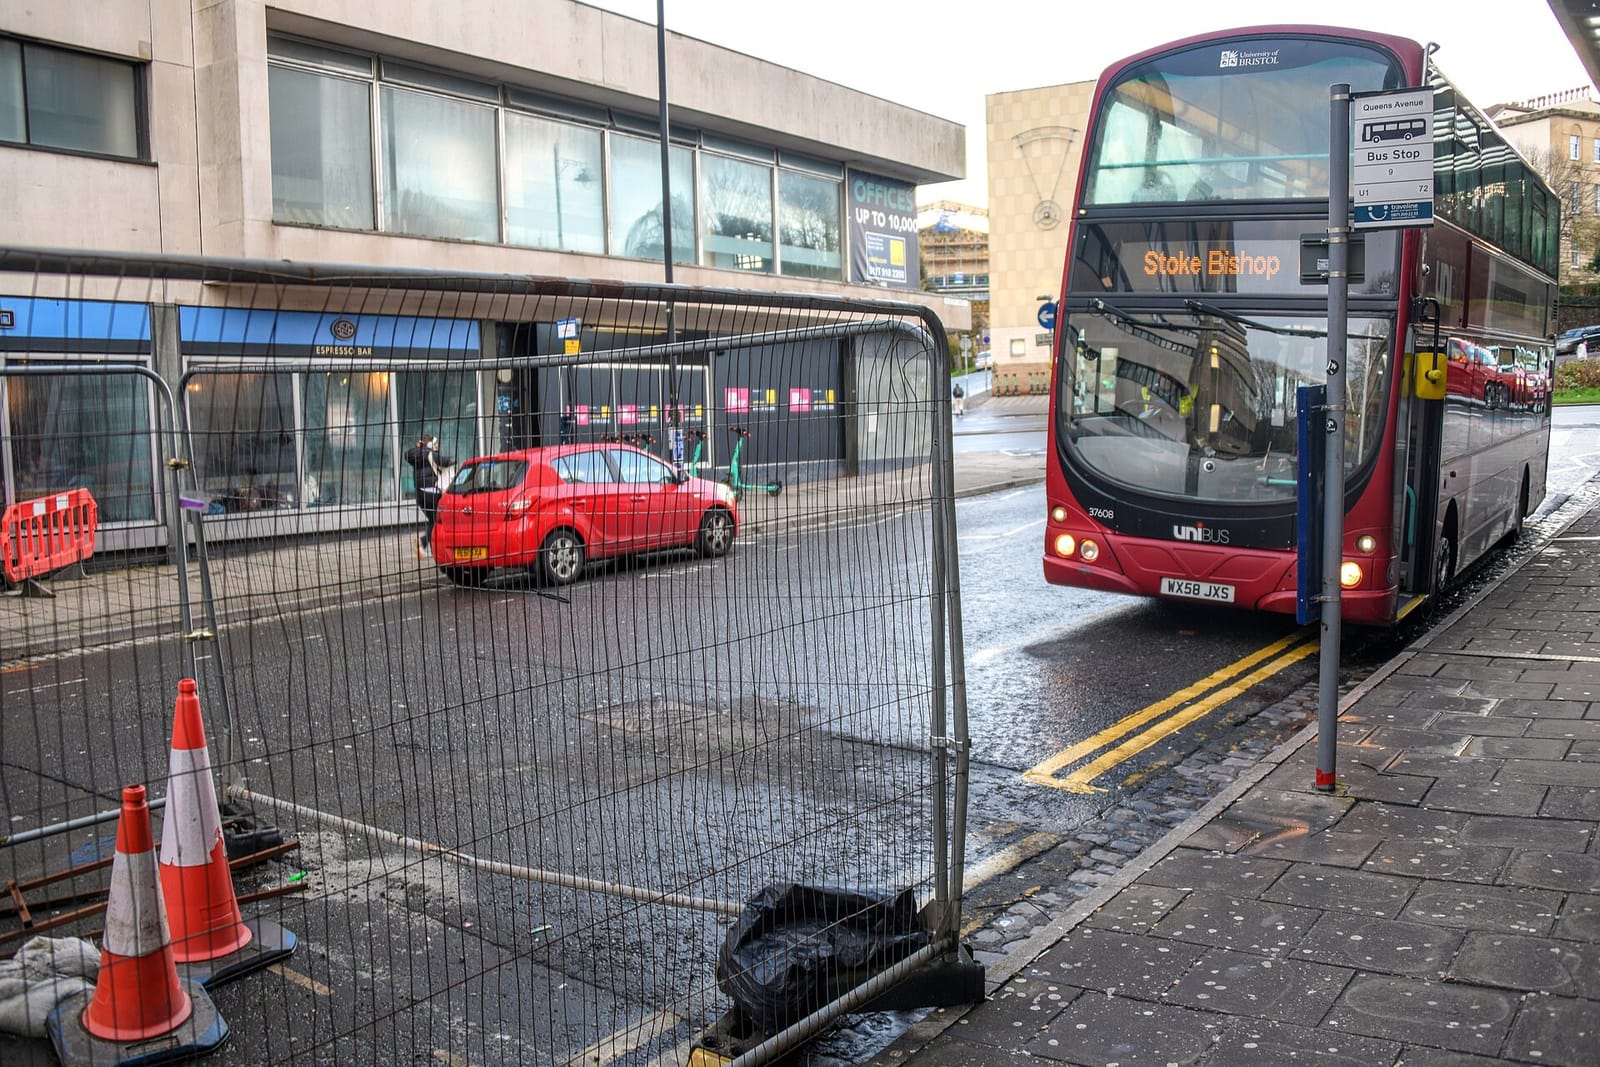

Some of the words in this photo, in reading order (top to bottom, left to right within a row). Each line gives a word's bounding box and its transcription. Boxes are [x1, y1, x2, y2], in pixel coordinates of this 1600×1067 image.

[1240, 51, 1270, 59] University
[1239, 57, 1280, 66] BRISTOL
[1394, 100, 1424, 108] Avenue
[1368, 152, 1388, 161] Bus
[1393, 150, 1420, 160] Stop
[854, 180, 913, 212] OFFICES
[856, 208, 870, 224] UP
[872, 211, 886, 228] TO
[888, 214, 918, 232] 10,000
[1144, 250, 1201, 275] Stoke
[1208, 250, 1280, 280] Bishop
[316, 346, 354, 356] ESPRESSO
[357, 347, 372, 356] BAR
[1088, 507, 1114, 518] 37608
[1173, 521, 1230, 544] uniBUS
[1168, 580, 1200, 596] WX58
[1204, 585, 1229, 600] JXS
